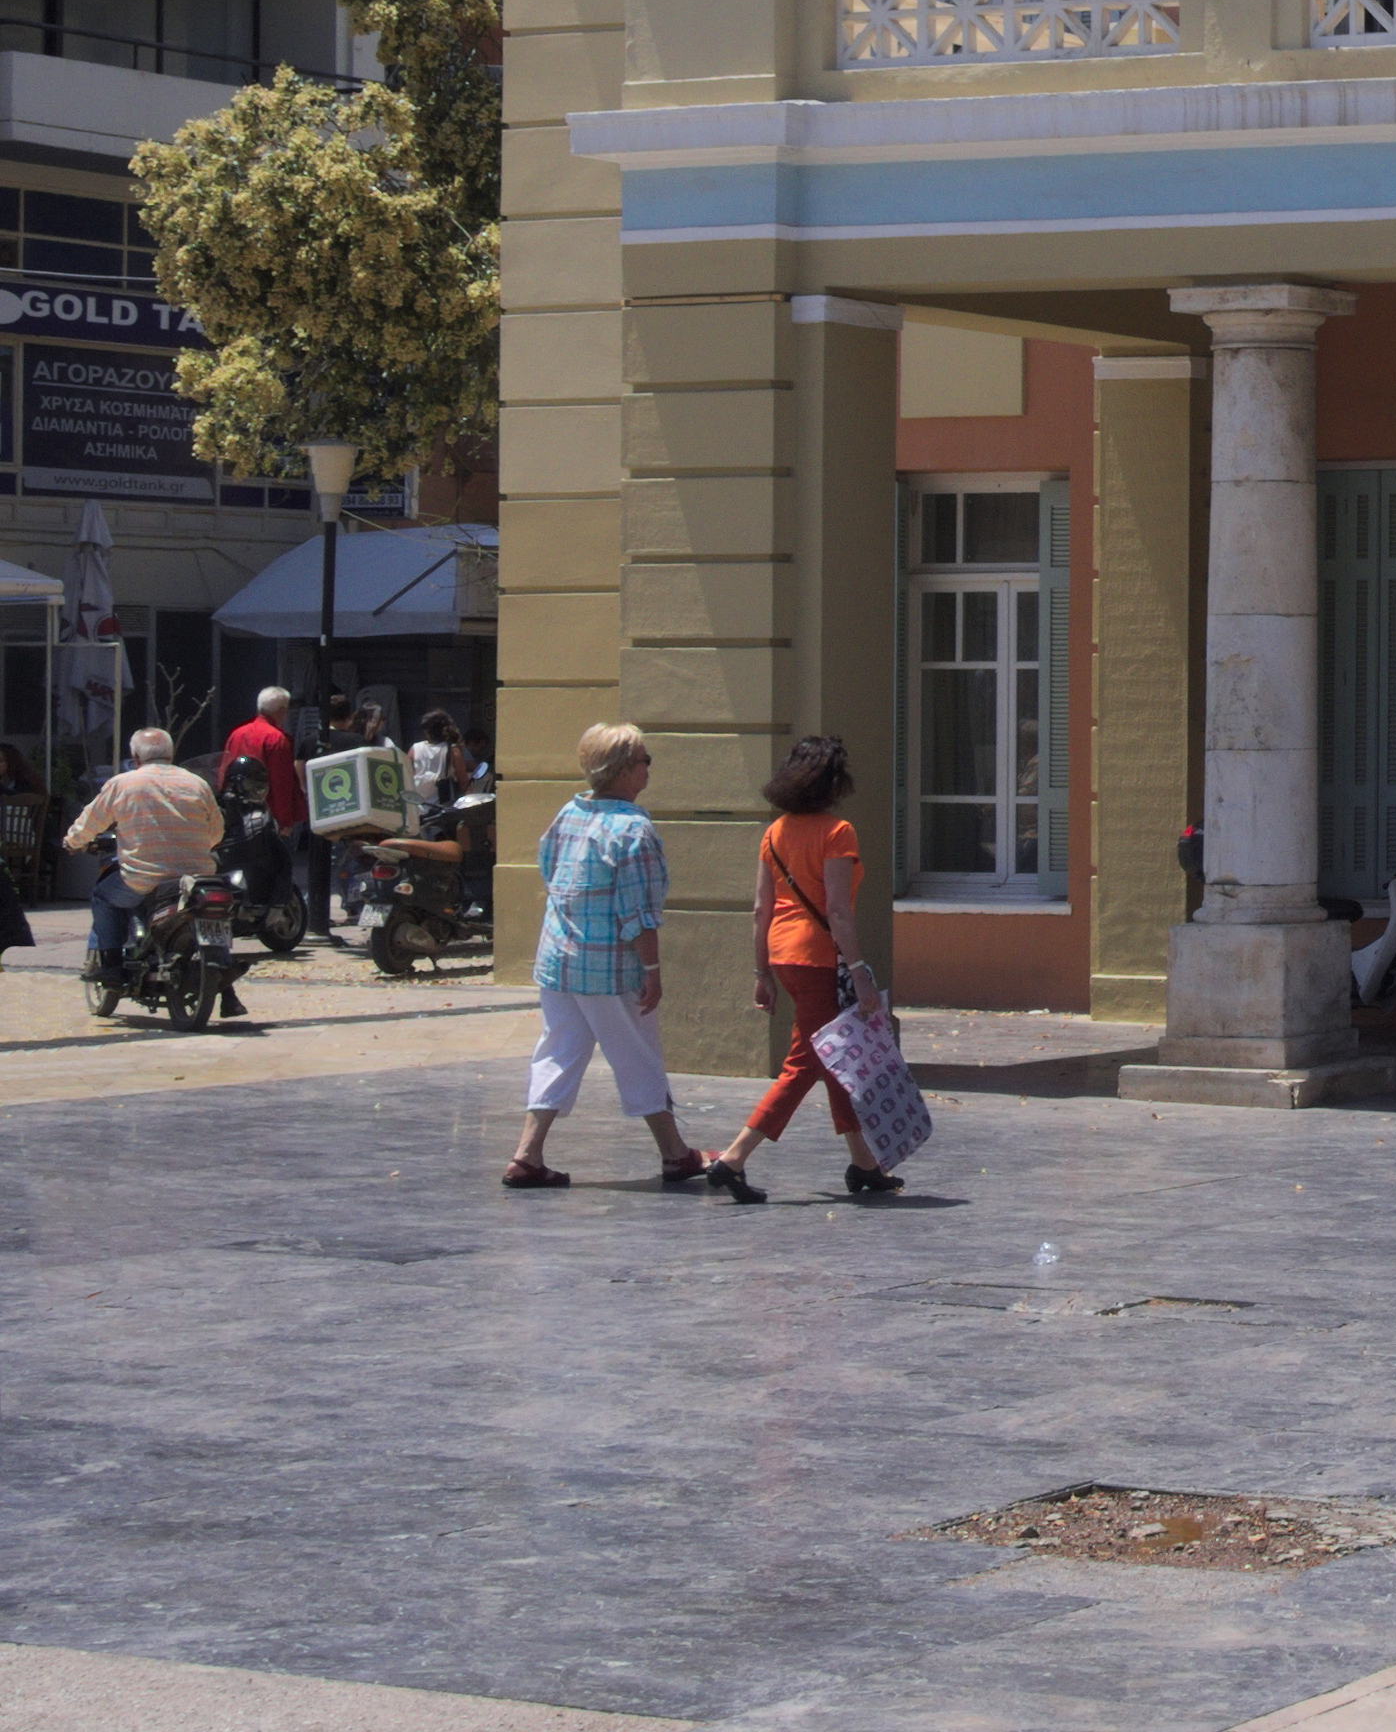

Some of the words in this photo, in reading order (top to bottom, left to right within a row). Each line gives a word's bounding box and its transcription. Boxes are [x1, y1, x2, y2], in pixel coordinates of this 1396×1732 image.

[20, 290, 139, 327] GOLD
[32, 360, 180, 390] ΑΓΟΡΑΖΟΥ
[40, 395, 96, 414] ΧΡΥΣΑ
[31, 416, 124, 437] ΔΙΑΜΑΝΤΙΑ
[83, 441, 158, 460] ΑΣΗΜΙΚΑ
[54, 474, 184, 493] www.goldtank.gr
